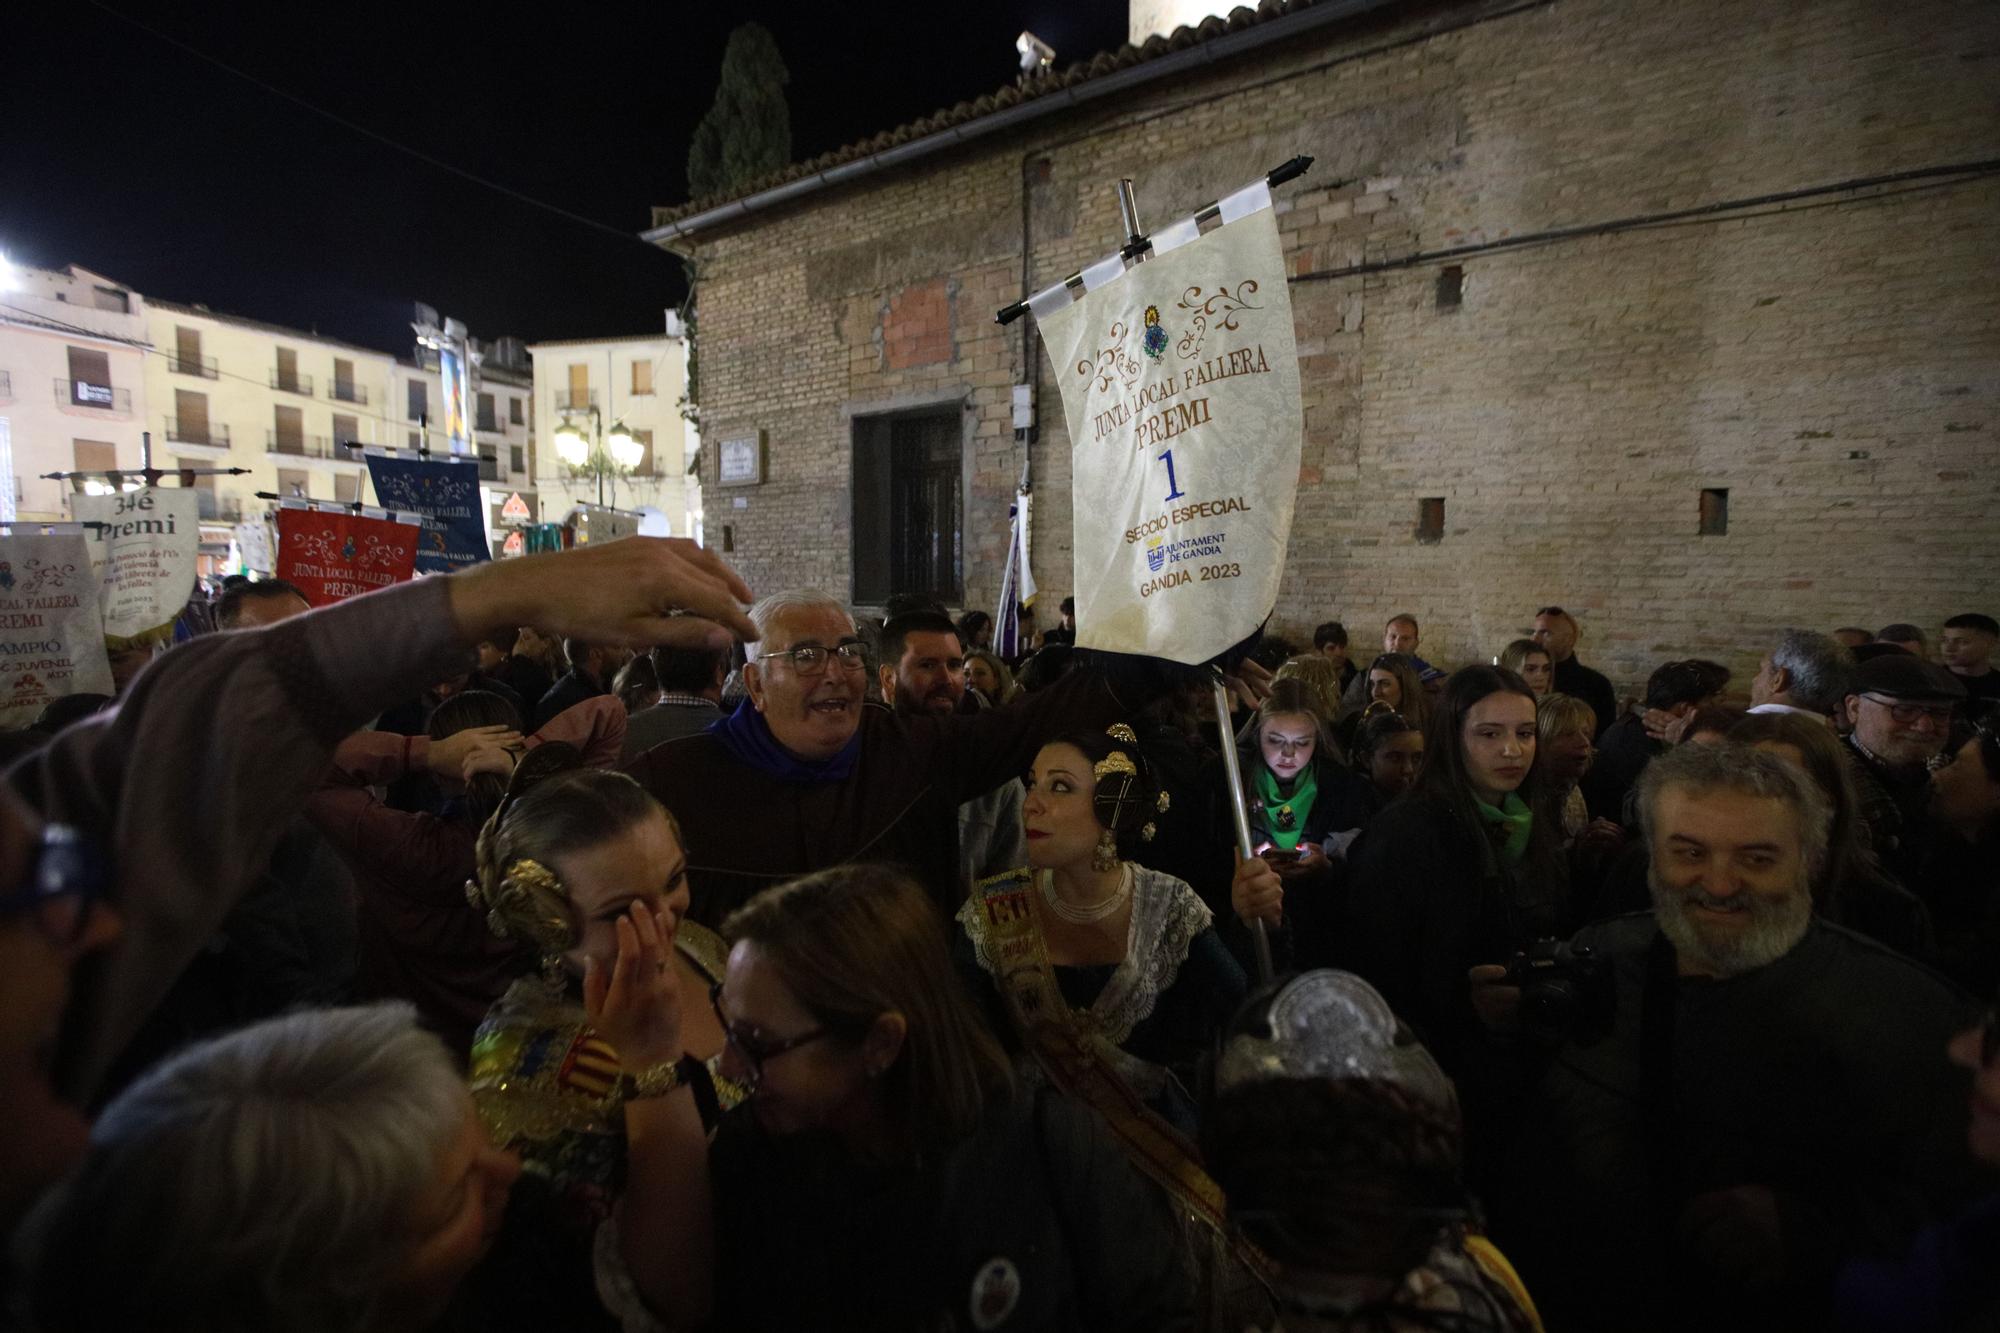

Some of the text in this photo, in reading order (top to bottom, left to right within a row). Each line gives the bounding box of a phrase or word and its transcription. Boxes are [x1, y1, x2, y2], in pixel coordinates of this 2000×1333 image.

[1094, 344, 1271, 442] JUNTA LOCAL FALLERA
[1134, 397, 1213, 450] PREMI
[1158, 449, 1185, 502] 1
[95, 513, 176, 541] Premi
[1125, 497, 1251, 544] SECCIÓ ESPECIAL
[1165, 533, 1226, 554] AJUNTAMENT
[1169, 545, 1222, 563] DE GANDIA
[292, 562, 398, 585] JUNTA LOCAL FALLERA
[1140, 563, 1241, 597] GANDIA 2023
[26, 594, 80, 609] FALLERA
[323, 581, 368, 598] PREMI
[15, 658, 74, 672] JUVENIL
